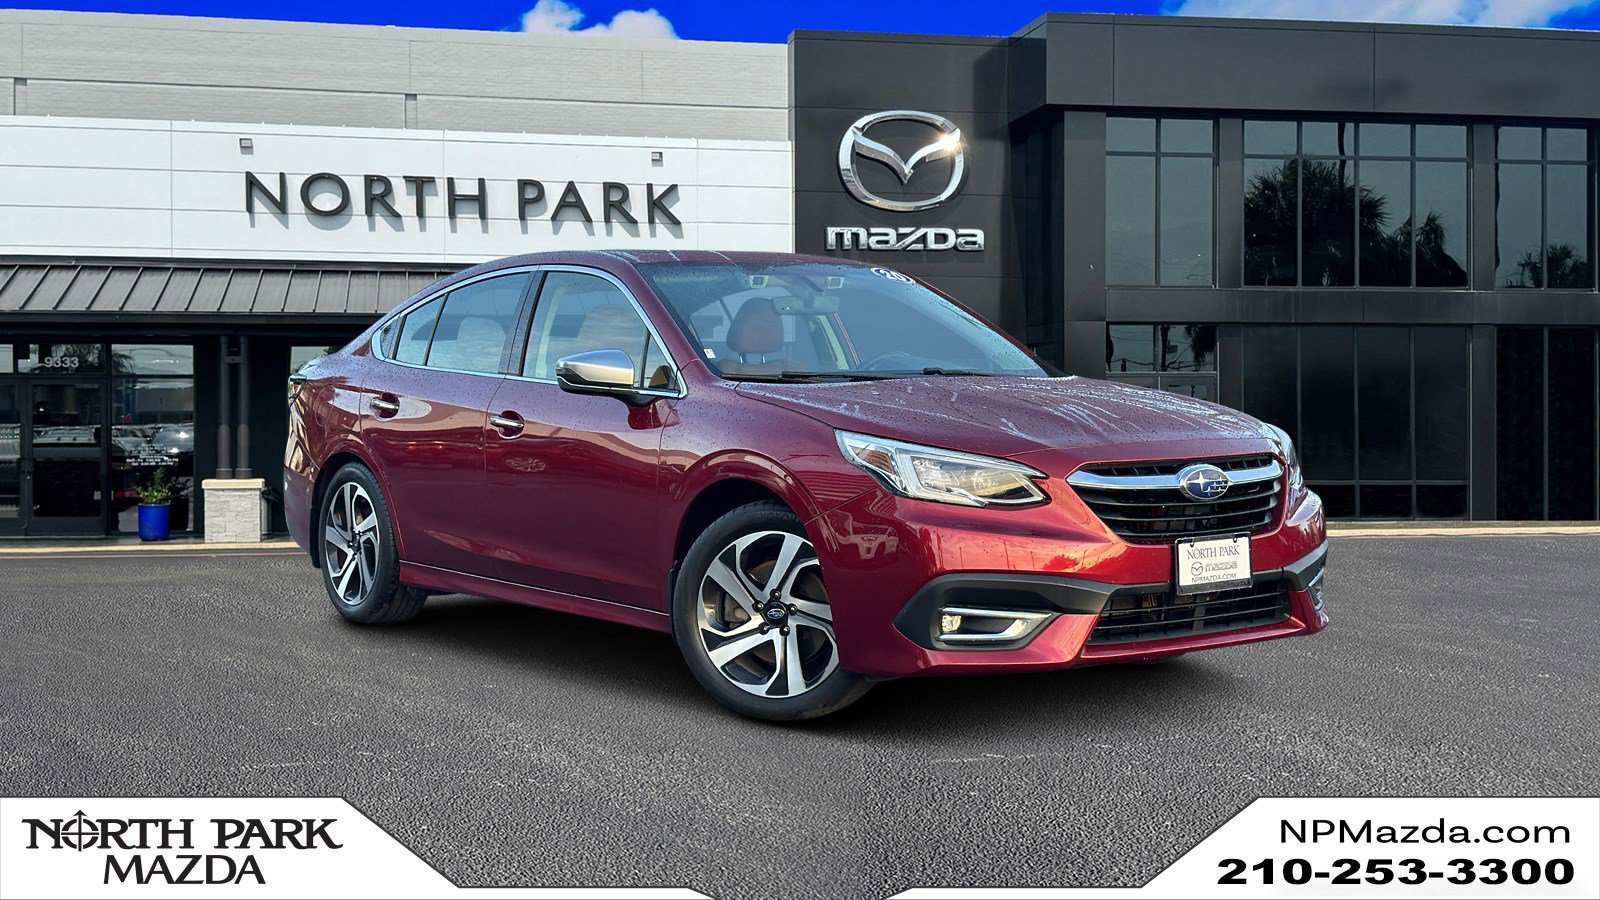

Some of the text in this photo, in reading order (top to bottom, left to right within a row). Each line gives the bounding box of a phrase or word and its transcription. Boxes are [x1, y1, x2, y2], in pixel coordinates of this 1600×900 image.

[245, 171, 682, 225] NORTH PARK
[44, 356, 79, 368] 9333
[1187, 544, 1240, 560] NORTH PARK
[1191, 573, 1237, 583] NPMAZDA.COM
